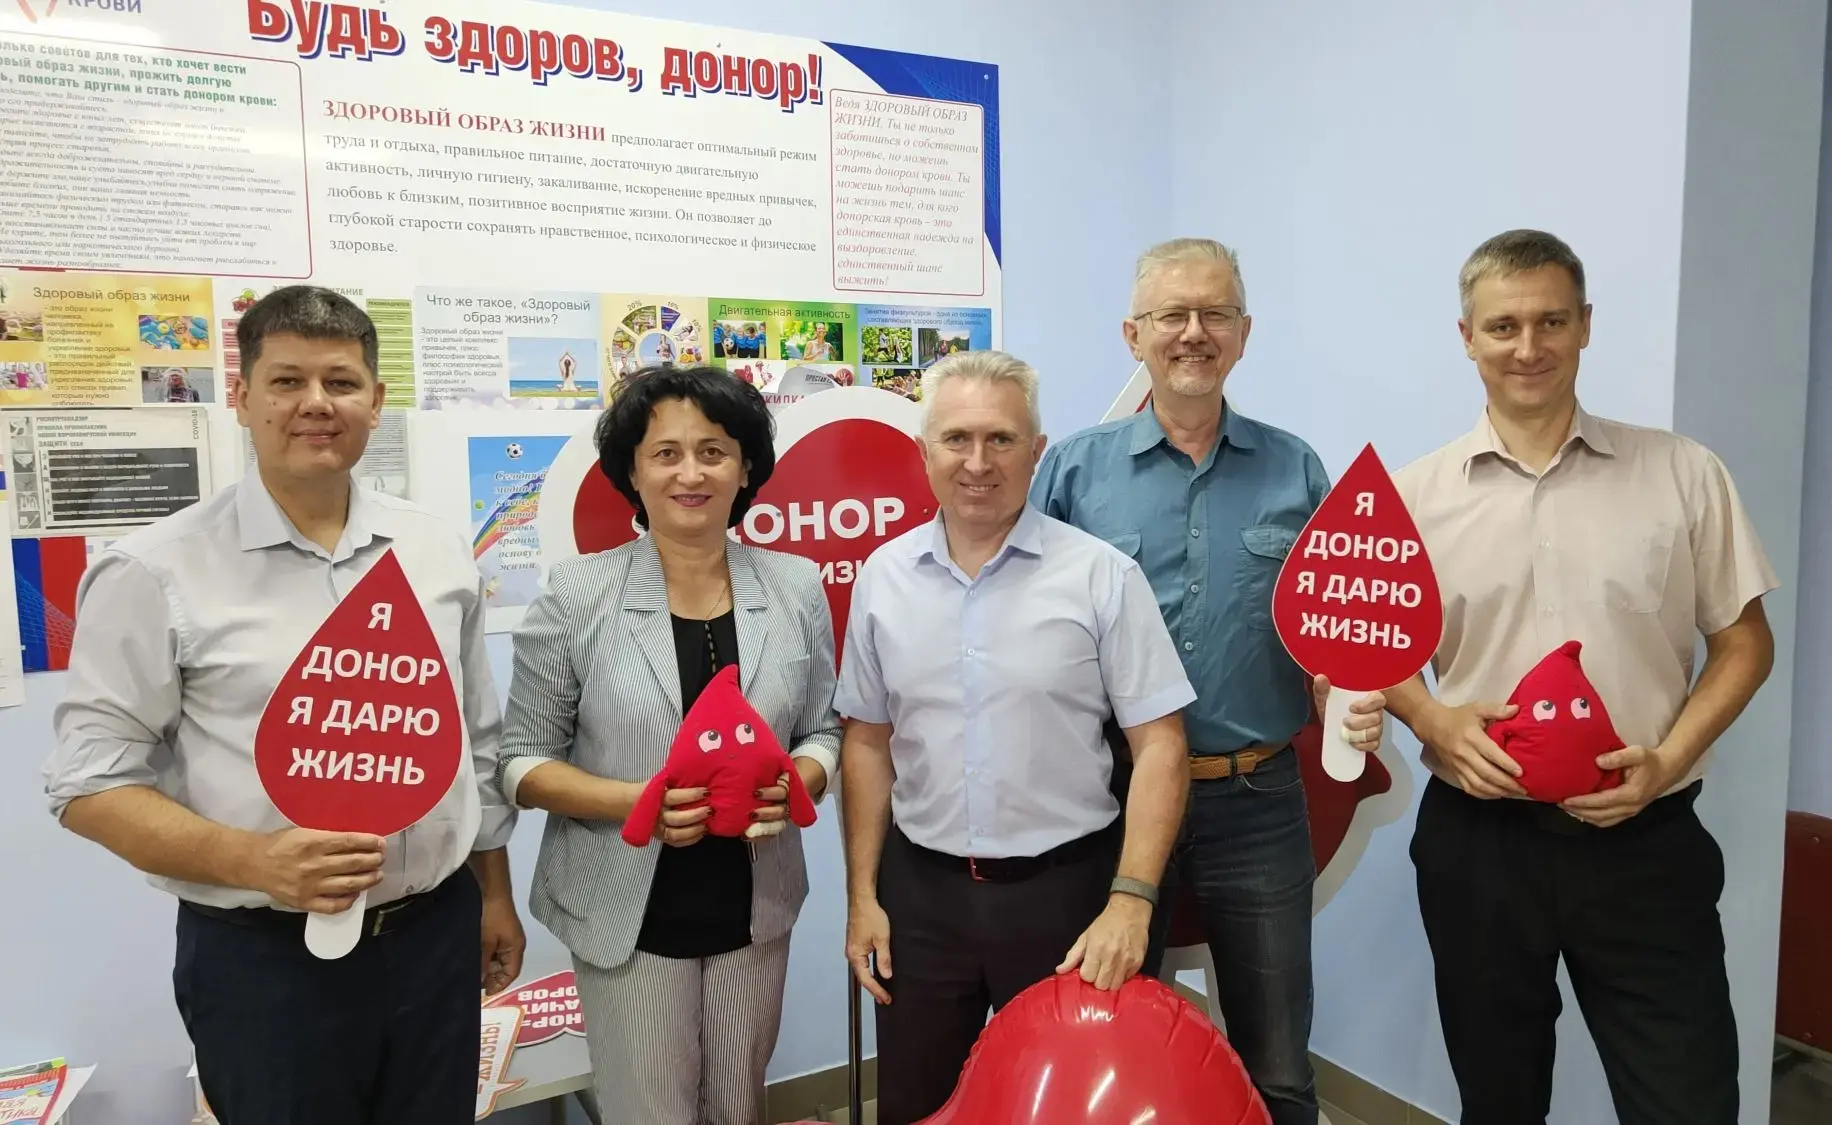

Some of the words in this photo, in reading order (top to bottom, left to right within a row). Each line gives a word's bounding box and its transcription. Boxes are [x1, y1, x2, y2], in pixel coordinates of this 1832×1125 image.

[40, 44, 90, 62] советов
[96, 51, 119, 65] для
[123, 54, 147, 67] тех,
[152, 57, 172, 68] кто
[177, 59, 209, 71] хочет
[214, 63, 246, 75] вести
[247, 0, 406, 61] Будь
[424, 15, 643, 92] здоров,
[660, 41, 824, 113] донор!
[36, 59, 74, 73] образ
[79, 64, 124, 78] жизни,
[130, 69, 182, 83] прожить
[187, 75, 231, 89] долгую
[18, 74, 79, 88] помогать
[84, 80, 130, 93] другим
[135, 85, 142, 94] и
[147, 86, 179, 98] стать
[184, 89, 235, 103] донором
[240, 95, 276, 107] крови:
[835, 96, 860, 109] Ведя
[865, 99, 929, 117] ЗДОРОВЫЙ
[933, 107, 967, 121] ОБРАЗ
[323, 99, 450, 127] ЗДОРОВЫЙ
[458, 114, 523, 134] ОБРАЗ
[530, 120, 604, 141] ЖИЗНИ
[612, 134, 694, 150] предполагает
[698, 142, 776, 158] оптимальный
[780, 151, 816, 162] режим
[835, 113, 882, 128] ЖИЗНИ.
[888, 118, 900, 130] Ты
[905, 123, 916, 132] не
[919, 124, 954, 136] только
[835, 130, 900, 146] заботишься
[904, 139, 910, 148] о
[913, 138, 978, 154] собственном
[324, 135, 365, 149] труда
[371, 138, 378, 149] и
[384, 140, 439, 155] отдыха,
[445, 145, 524, 160] правильное
[530, 152, 586, 166] питание,
[591, 158, 672, 175] достаточную
[676, 164, 758, 182] двигательную
[836, 146, 884, 161] здоровье,
[889, 153, 901, 161] но
[904, 154, 948, 167] можешь
[326, 161, 412, 178] активность,
[417, 168, 472, 184] личную
[478, 172, 533, 188] гигиену,
[538, 177, 621, 193] закаливание,
[626, 185, 702, 199] искоренение
[707, 191, 755, 203] вредных
[760, 195, 816, 209] привычек,
[836, 164, 871, 175] стать
[875, 164, 919, 180] донором
[923, 172, 952, 183] крови.
[958, 171, 970, 184] Ты
[836, 180, 882, 191] можешь
[886, 183, 935, 196] подарить
[940, 188, 965, 199] шанс
[328, 187, 382, 200] любовь
[388, 191, 395, 201] к
[400, 190, 463, 206] близким,
[469, 197, 547, 211] позитивное
[552, 202, 625, 216] восприятие
[629, 208, 671, 219] жизни.
[676, 209, 692, 221] Он
[698, 213, 753, 225] позволяет
[759, 217, 772, 228] до
[836, 196, 849, 205] на
[854, 197, 886, 208] жизнь
[890, 200, 913, 211] тем,
[918, 200, 934, 211] для
[938, 204, 958, 216] кого
[837, 212, 891, 225] донорская
[894, 216, 922, 227] кровь
[934, 219, 952, 228] это
[329, 213, 394, 227] глубокой
[399, 218, 462, 232] старости
[467, 222, 535, 236] сохранять
[541, 226, 631, 241] нравственное,
[636, 232, 737, 247] психологическое
[741, 239, 747, 248] и
[752, 237, 816, 252] физическое
[837, 227, 910, 241] единственная
[914, 232, 959, 244] надежда
[963, 236, 973, 245] на
[330, 240, 397, 254] здоровье.
[837, 244, 916, 257] выздоровление,
[838, 259, 913, 271] единственный
[917, 264, 942, 273] шанс
[330, 287, 363, 296] ТАНИЕ
[838, 276, 888, 286] выжить!
[33, 287, 104, 302] Здоровый
[107, 289, 146, 304] образ
[151, 292, 190, 302] жизни
[427, 294, 451, 306] Что
[455, 298, 472, 307] же
[477, 298, 516, 310] такое,
[521, 298, 590, 312] «Здоровый
[464, 311, 501, 325] образ
[505, 313, 558, 324] жизни»?
[719, 304, 792, 318] Двигательная
[794, 307, 851, 319] активность
[1354, 491, 1375, 517] Я
[728, 497, 905, 544] ОНОР
[1303, 529, 1420, 564] ДОНОР
[1295, 571, 1315, 595] Я
[1322, 574, 1422, 608] ДАРЮ
[368, 602, 393, 631] Я
[1299, 612, 1412, 650] ЖИЗНЬ
[301, 645, 441, 686] ДОНОР
[287, 696, 314, 725] Я
[320, 699, 440, 736] ДАРЮ
[287, 747, 425, 785] ЖИЗНЬ
[517, 985, 578, 1001] ОРОВ
[523, 998, 580, 1015] АЧИТ
[520, 1012, 583, 1029] НОР=
